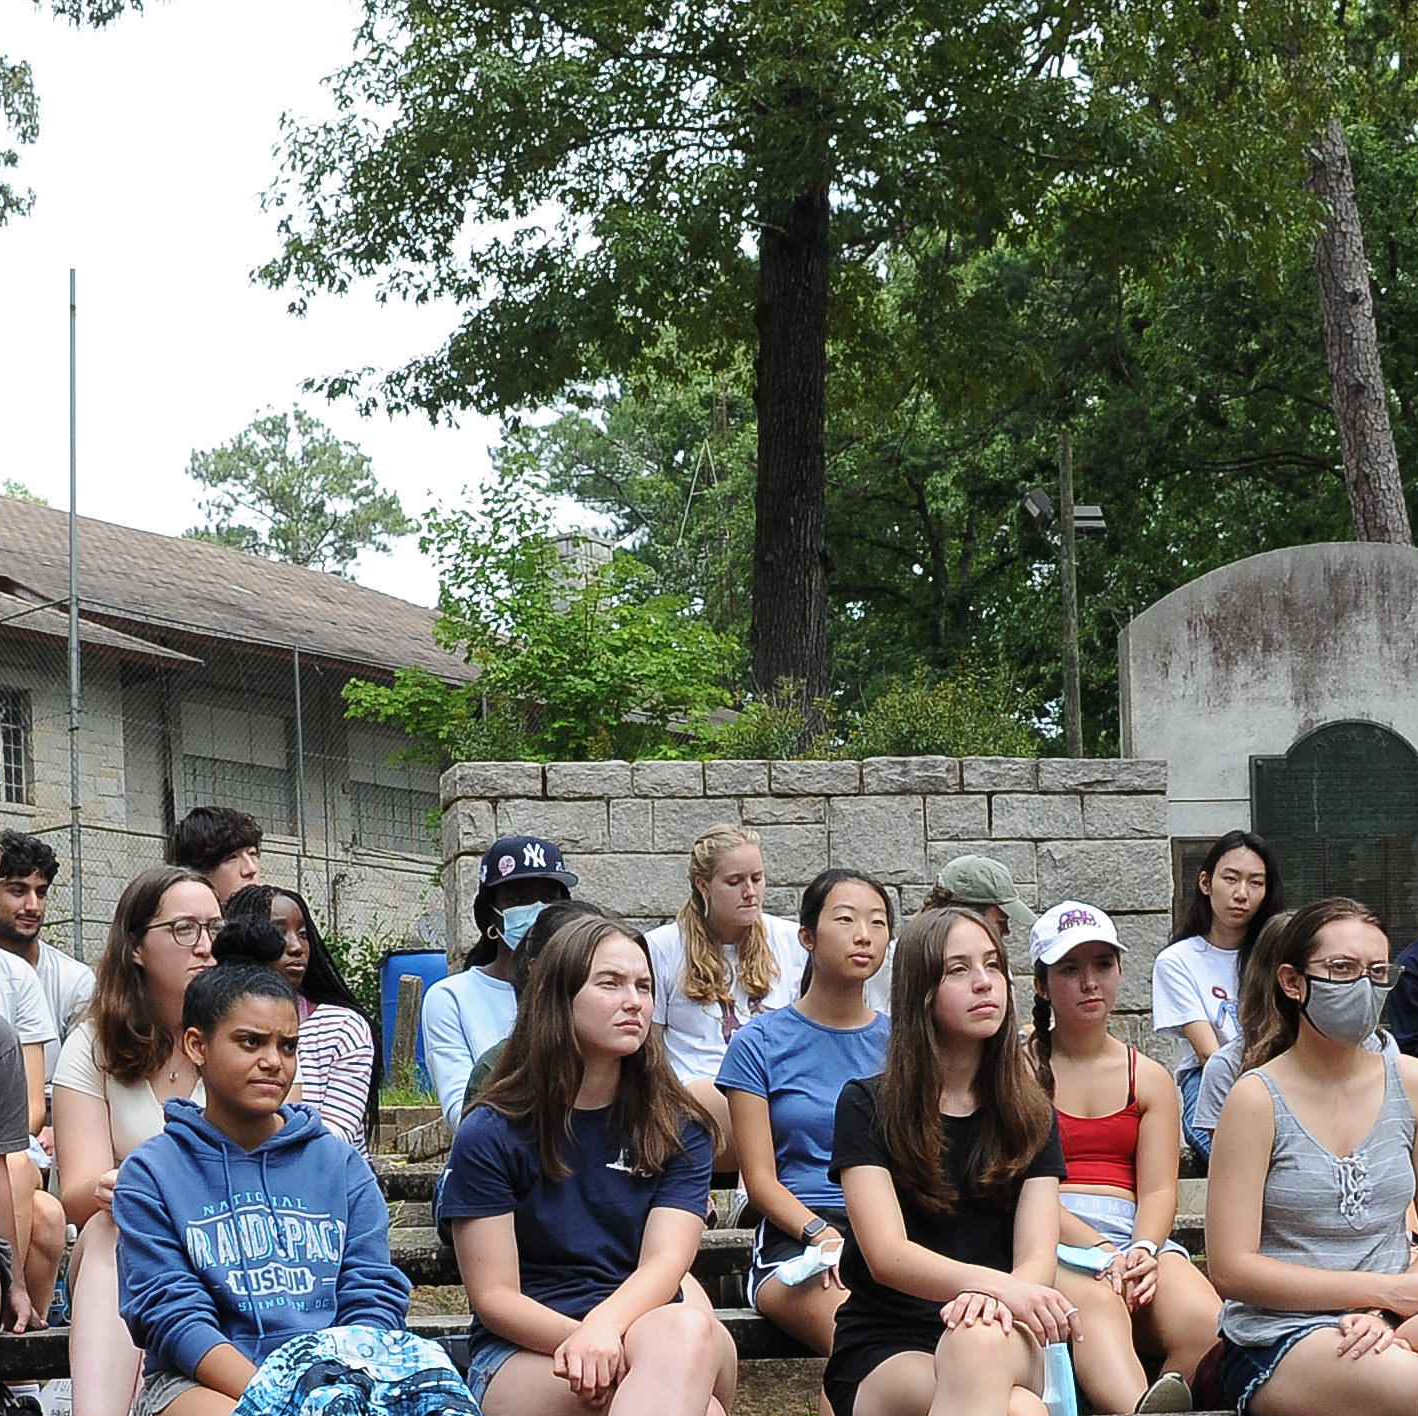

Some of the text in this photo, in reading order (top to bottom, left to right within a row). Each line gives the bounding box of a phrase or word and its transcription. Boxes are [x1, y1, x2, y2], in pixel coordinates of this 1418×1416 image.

[523, 843, 547, 868] NY
[203, 1192, 308, 1216] NATIONAL
[1075, 1197, 1131, 1216] ARMO
[186, 1227, 218, 1272] IR
[268, 1215, 348, 1268] SPAC
[231, 1266, 310, 1294] MUSEUM
